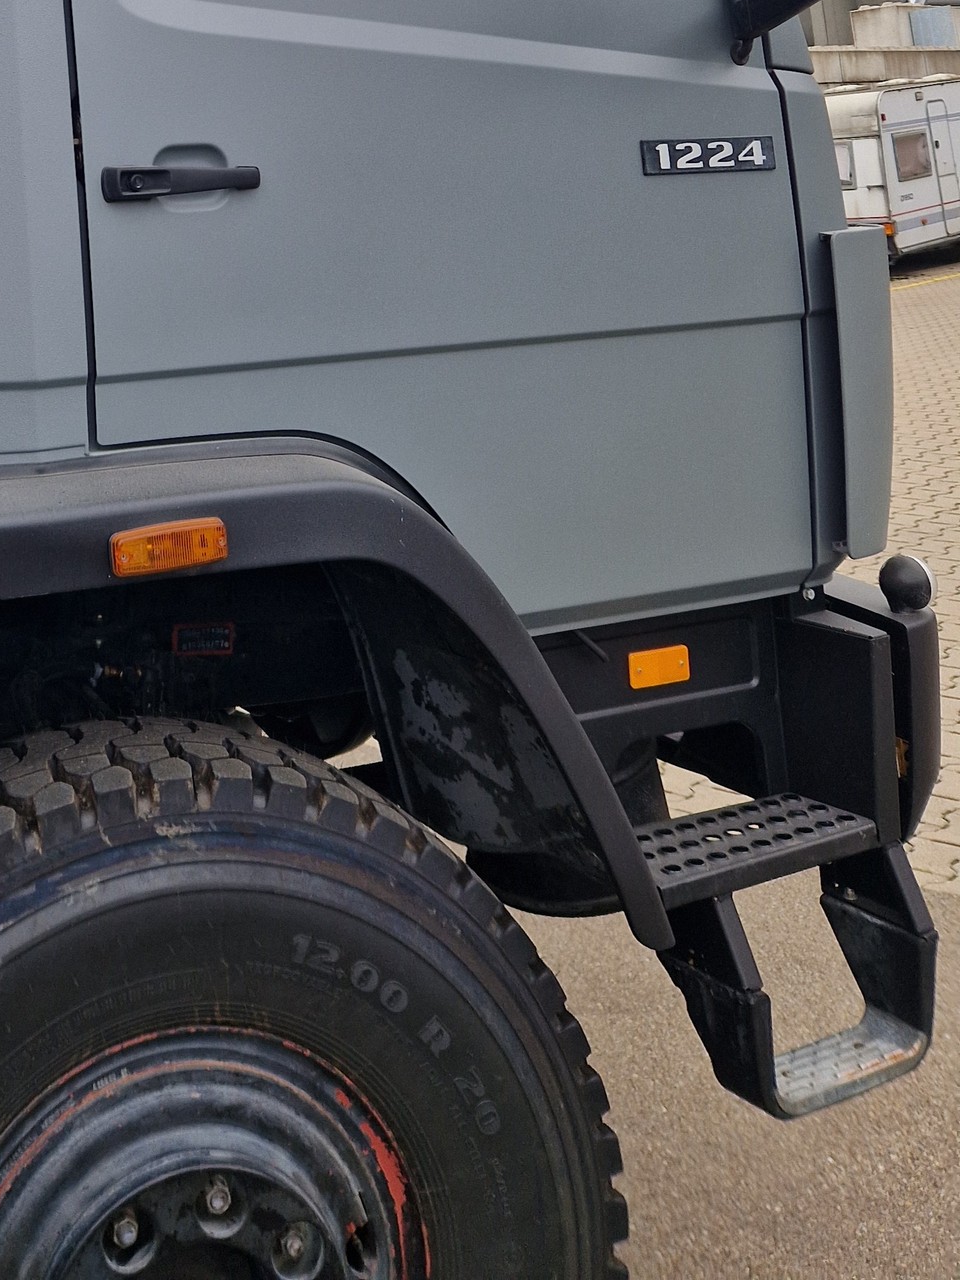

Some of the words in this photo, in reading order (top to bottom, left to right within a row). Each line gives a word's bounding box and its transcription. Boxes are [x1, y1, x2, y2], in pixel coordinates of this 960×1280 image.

[655, 140, 767, 170] 1224
[292, 933, 409, 1014] 12.00
[417, 1014, 453, 1059] R
[452, 1065, 501, 1136] 20
